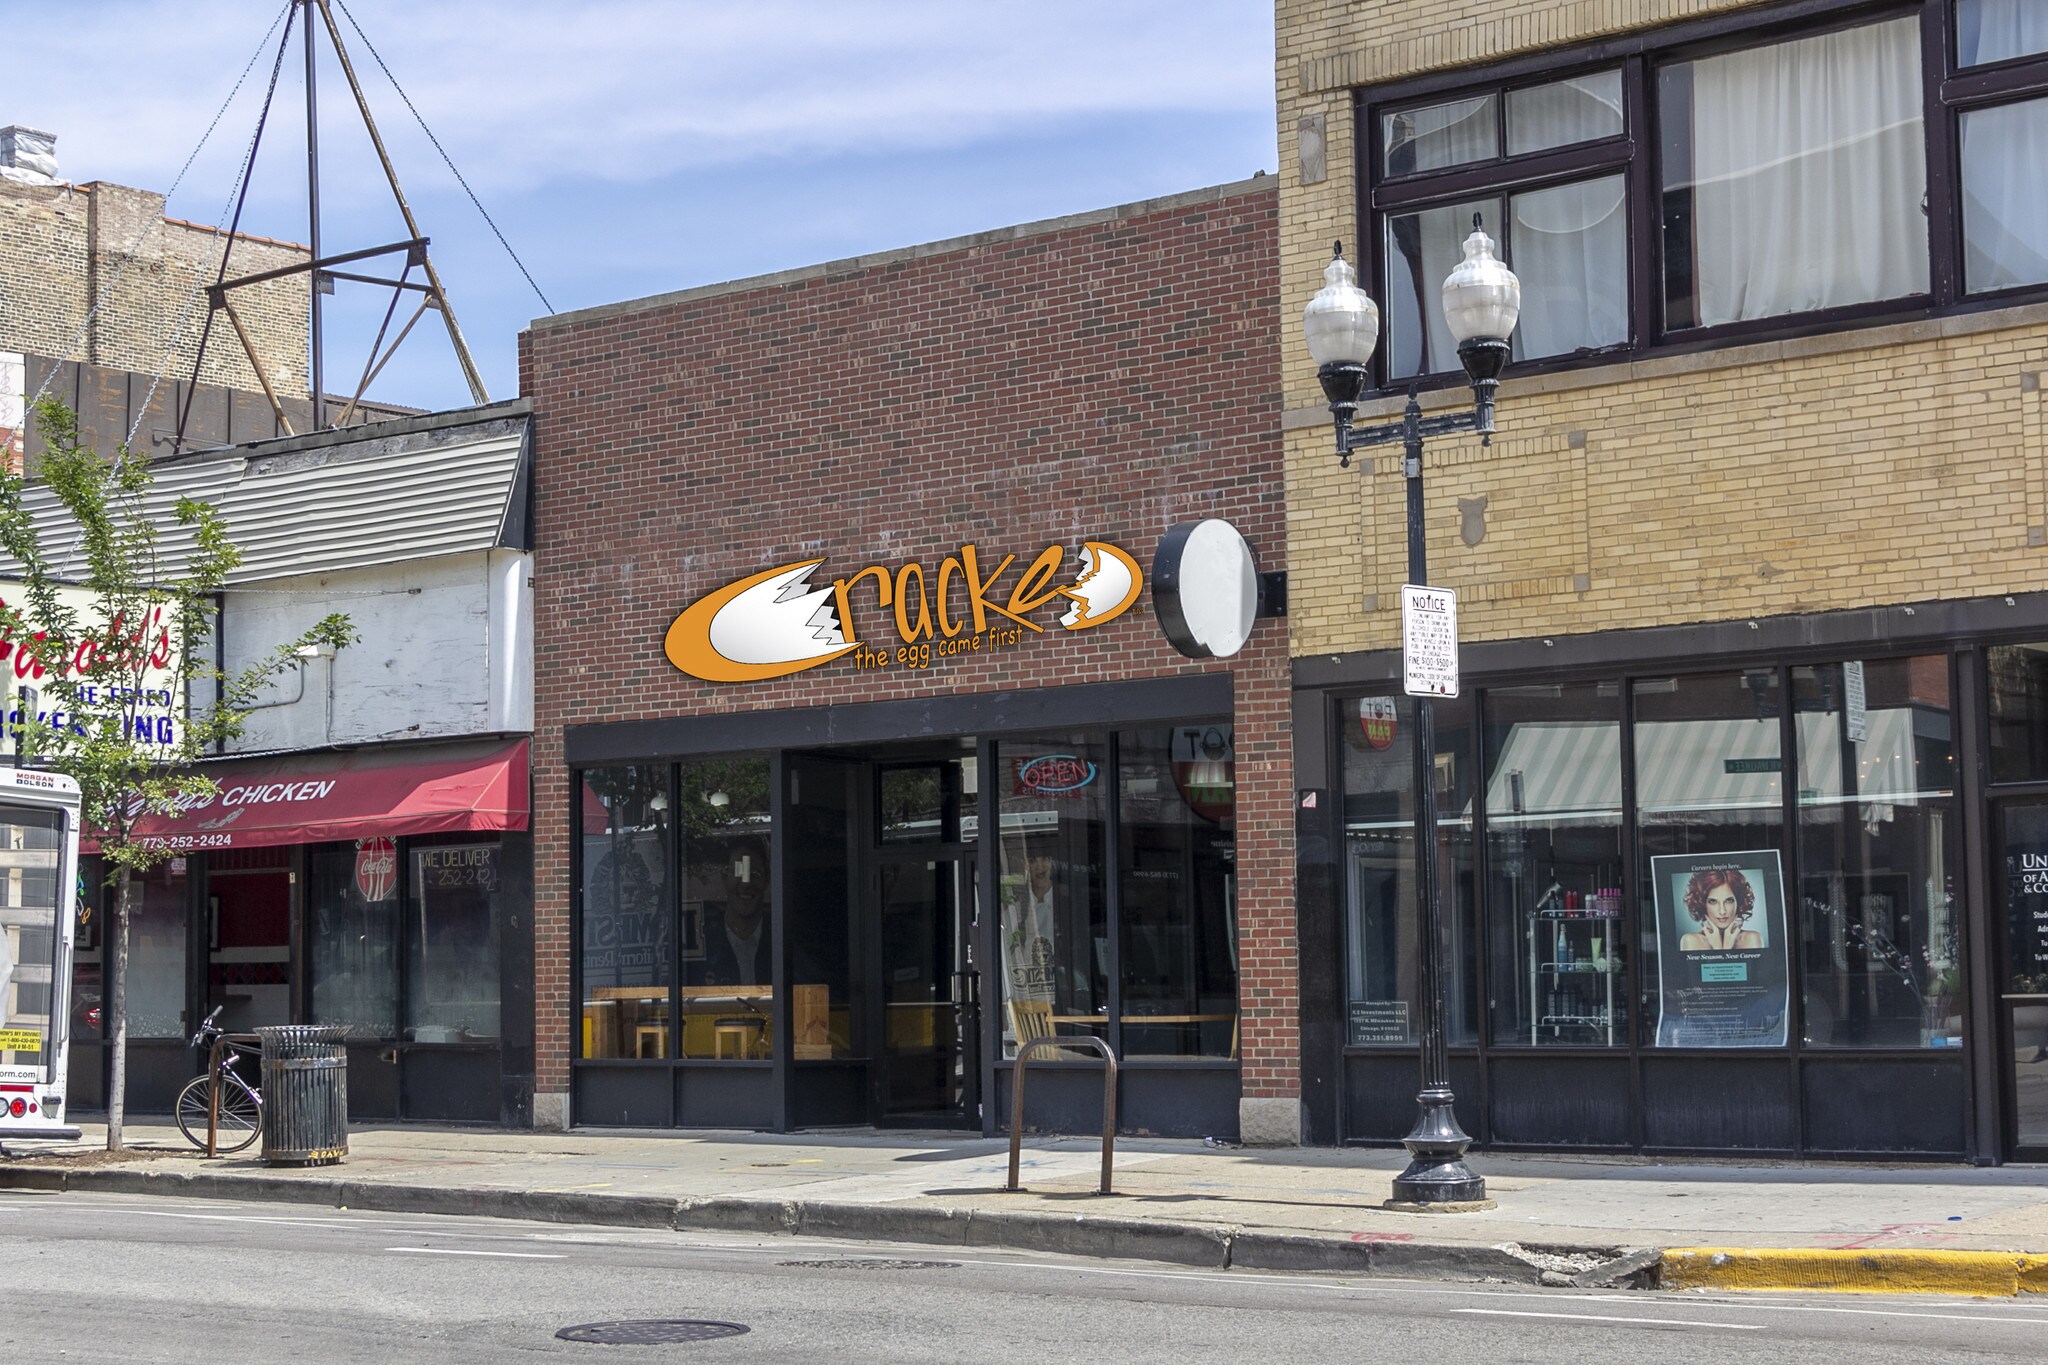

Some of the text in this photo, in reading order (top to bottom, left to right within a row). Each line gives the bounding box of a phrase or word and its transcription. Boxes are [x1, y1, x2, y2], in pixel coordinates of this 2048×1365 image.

[1412, 596, 1446, 611] NOTICE
[855, 626, 1024, 671] the egg came first
[1409, 656, 1420, 666] FINE
[16, 773, 54, 783] MORGAN
[1025, 759, 1088, 787] OPEN
[222, 780, 336, 807] CHICKEN
[142, 834, 232, 849] 773-252-2424
[442, 848, 491, 868] DELIVER
[1713, 863, 1727, 871] begin
[2023, 874, 2037, 883] OF
[2023, 884, 2033, 894] &
